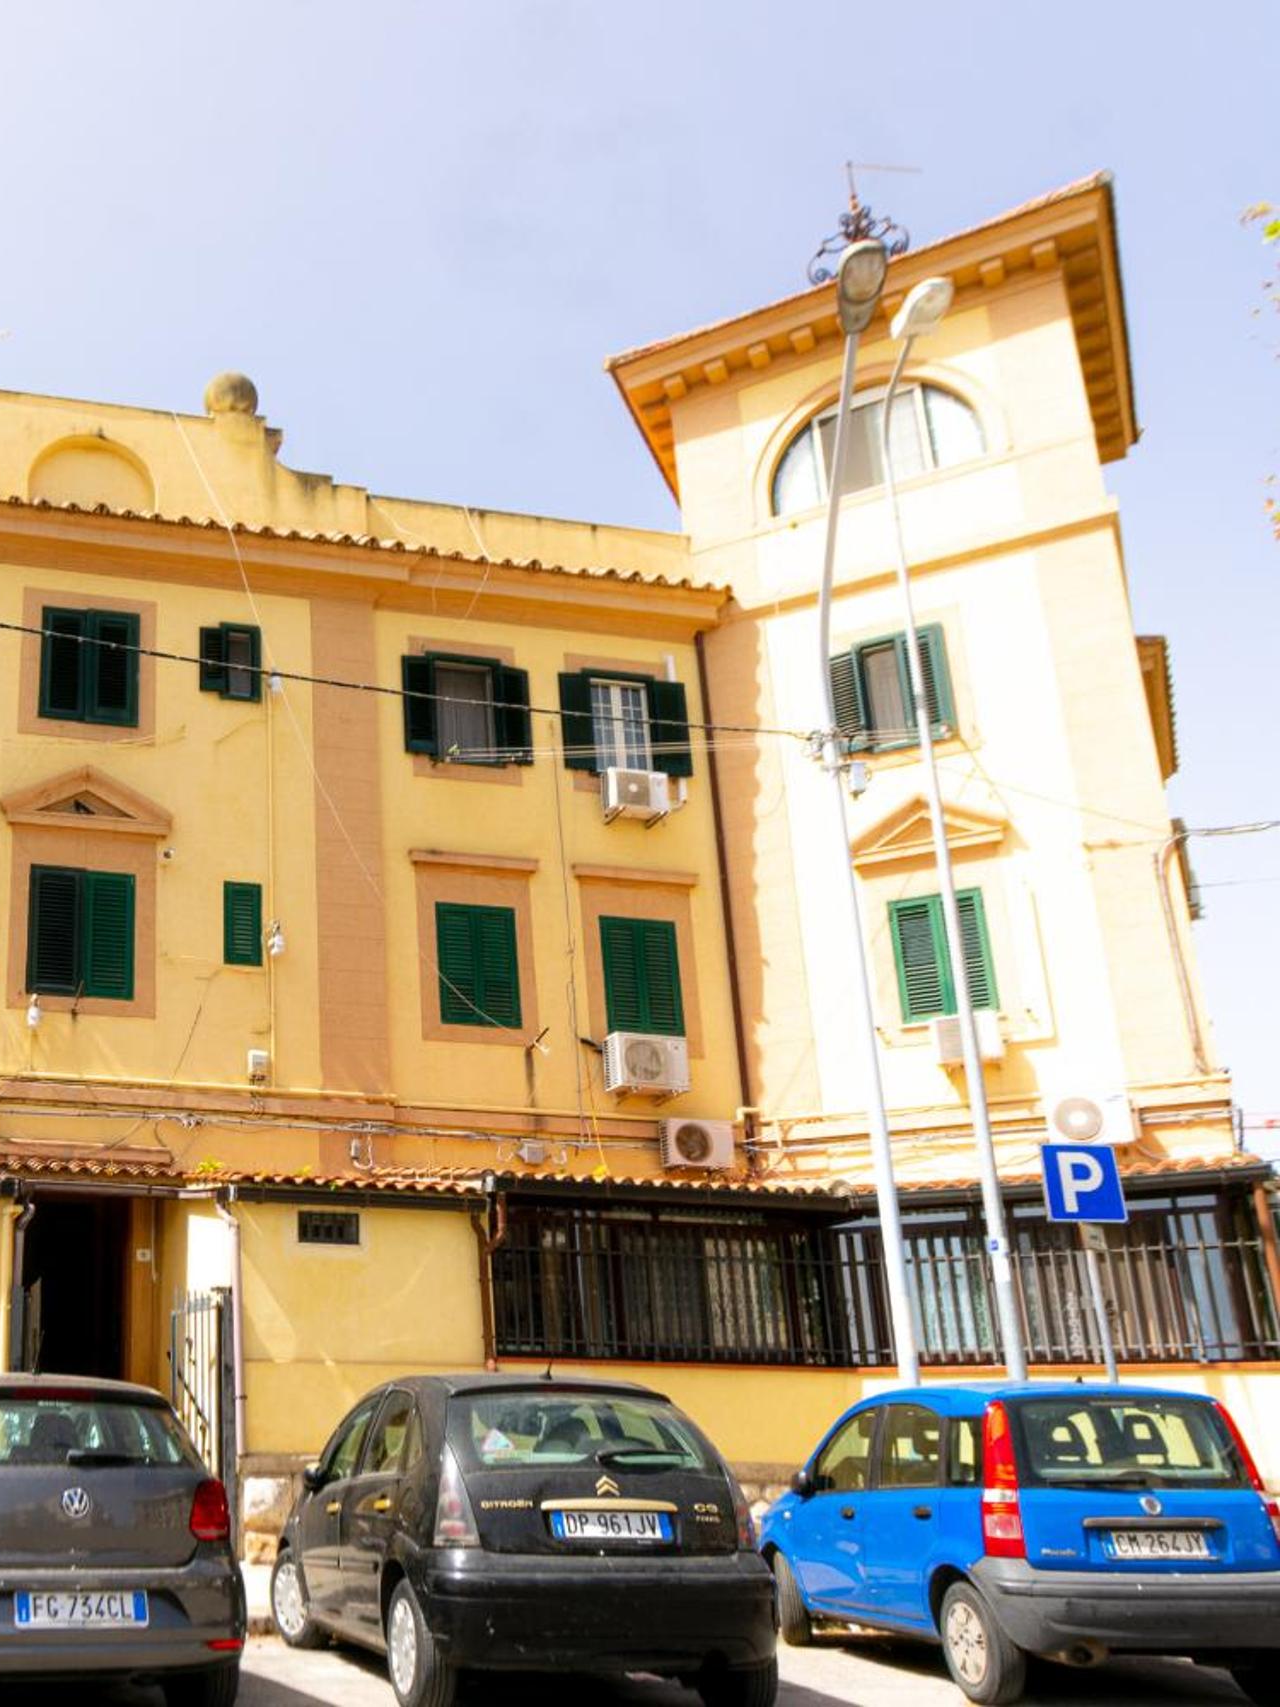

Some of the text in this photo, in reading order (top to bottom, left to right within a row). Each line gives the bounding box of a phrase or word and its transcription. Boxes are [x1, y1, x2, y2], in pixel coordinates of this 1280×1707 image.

[1055, 1151, 1105, 1214] P
[565, 1513, 591, 1535] DP
[596, 1512, 658, 1536] 961JV
[1115, 1531, 1144, 1555] CM
[32, 1595, 59, 1619] FG
[66, 1594, 133, 1619] 734CL
